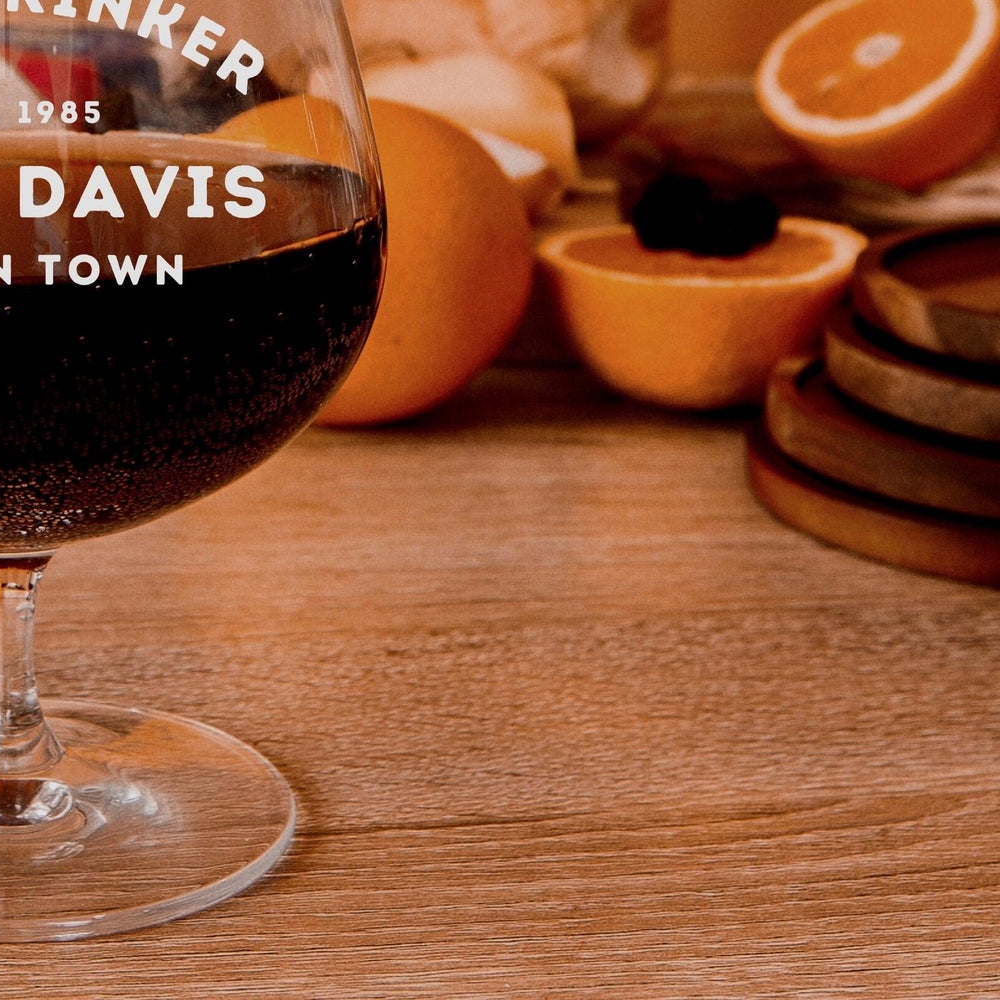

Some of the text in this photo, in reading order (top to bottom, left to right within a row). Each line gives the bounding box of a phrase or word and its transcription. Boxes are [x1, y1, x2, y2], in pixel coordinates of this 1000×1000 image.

[18, 101, 101, 124] 1985
[20, 165, 267, 218] DAVIS
[38, 254, 184, 286] TOWN
